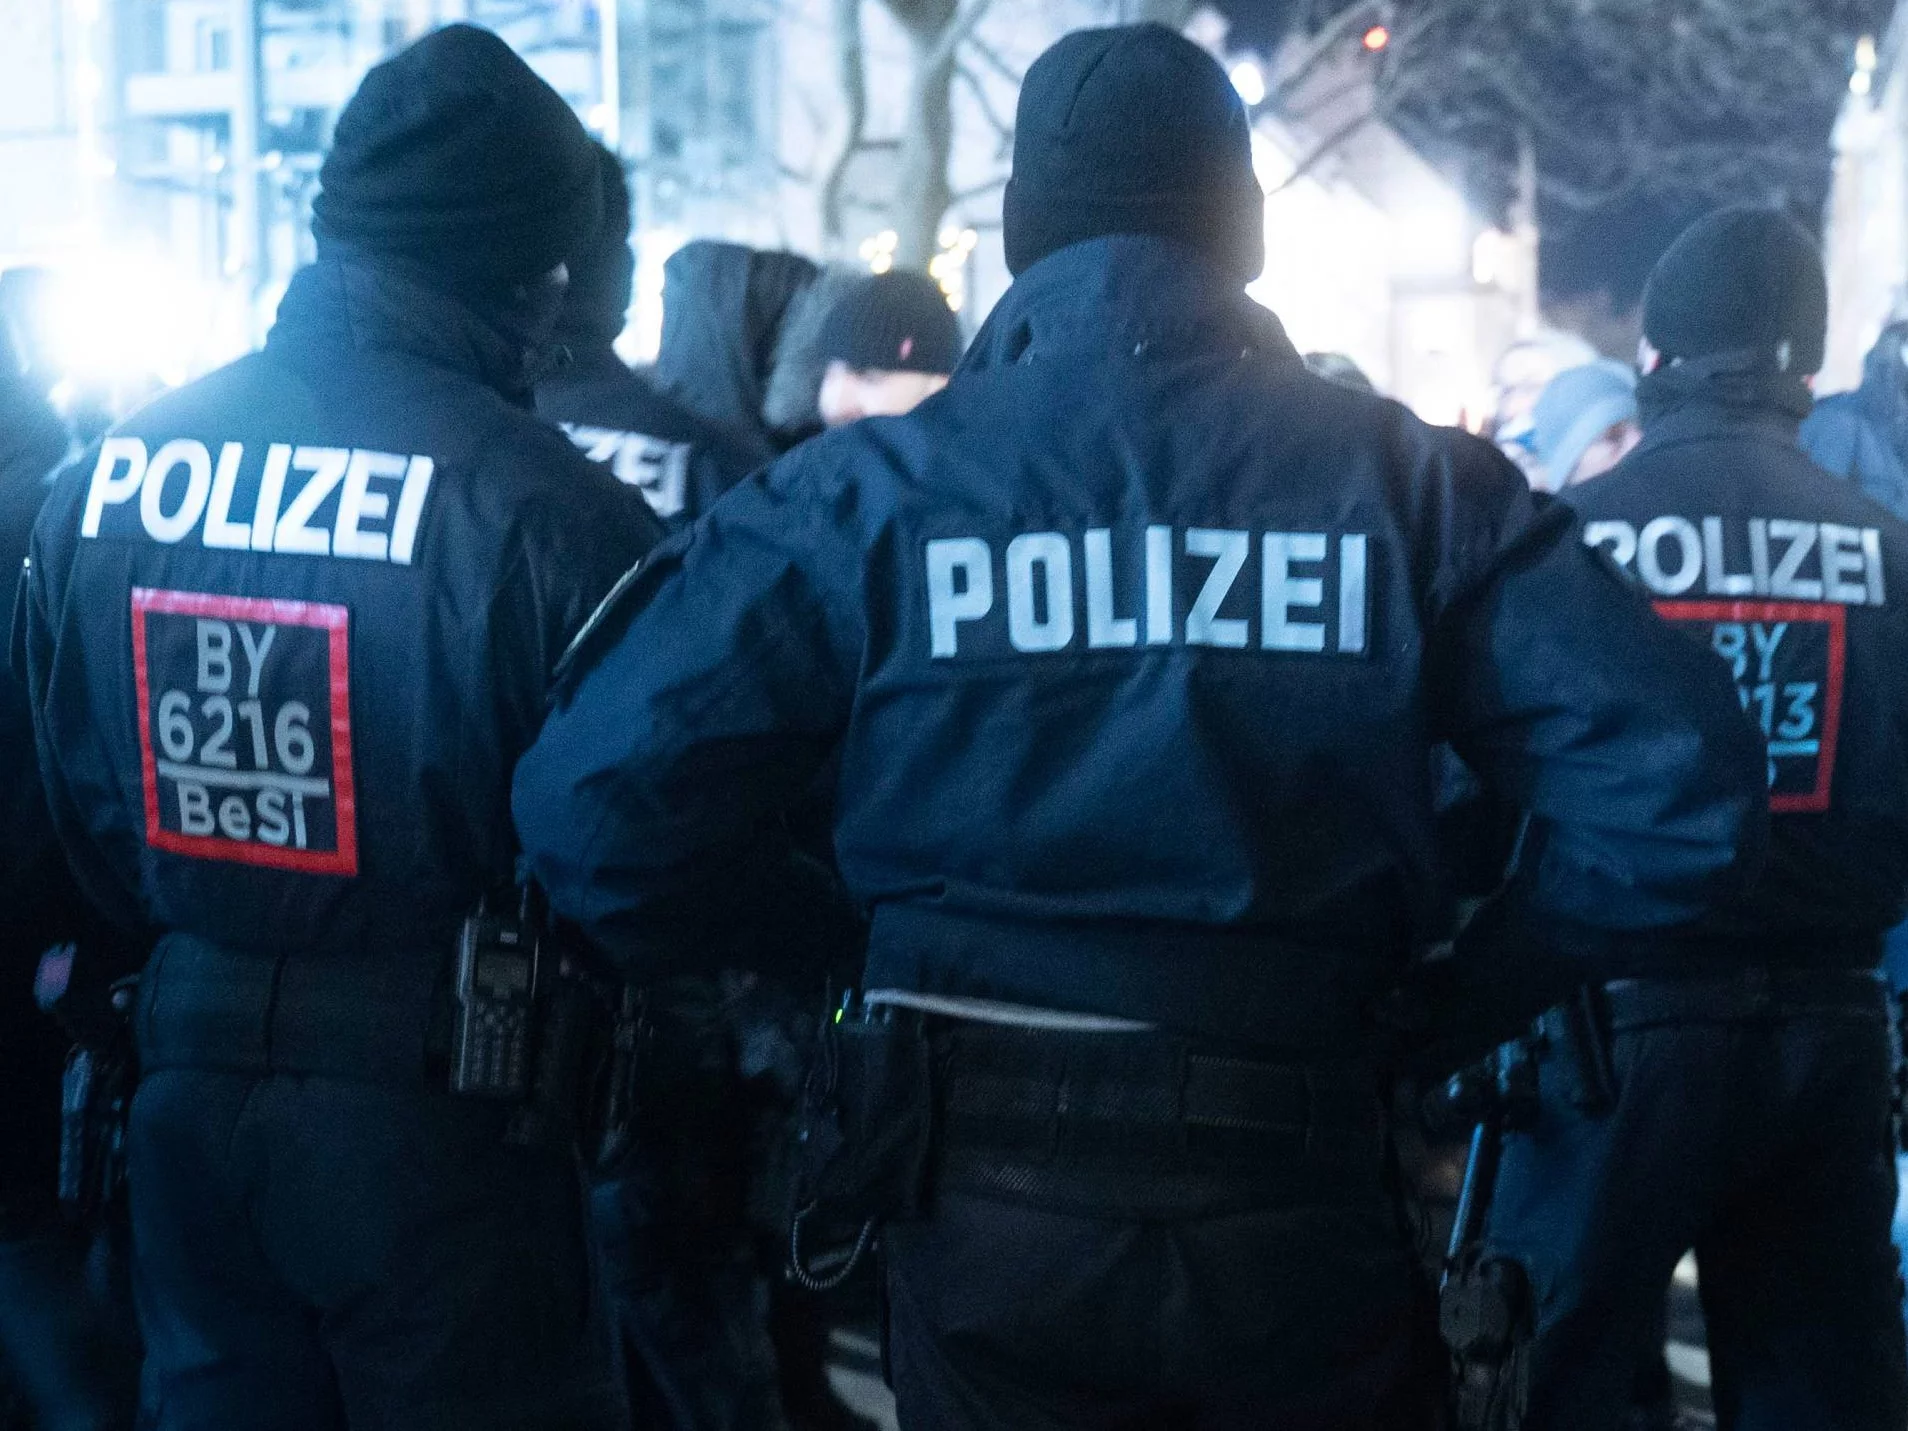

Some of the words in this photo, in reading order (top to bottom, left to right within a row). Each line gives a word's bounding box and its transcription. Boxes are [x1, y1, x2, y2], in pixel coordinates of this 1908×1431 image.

[81, 436, 434, 565] POLIZEI
[926, 525, 1367, 658] POLIZEI
[196, 619, 276, 698] BY
[158, 689, 315, 776] 6216
[1738, 682, 1818, 740] 13
